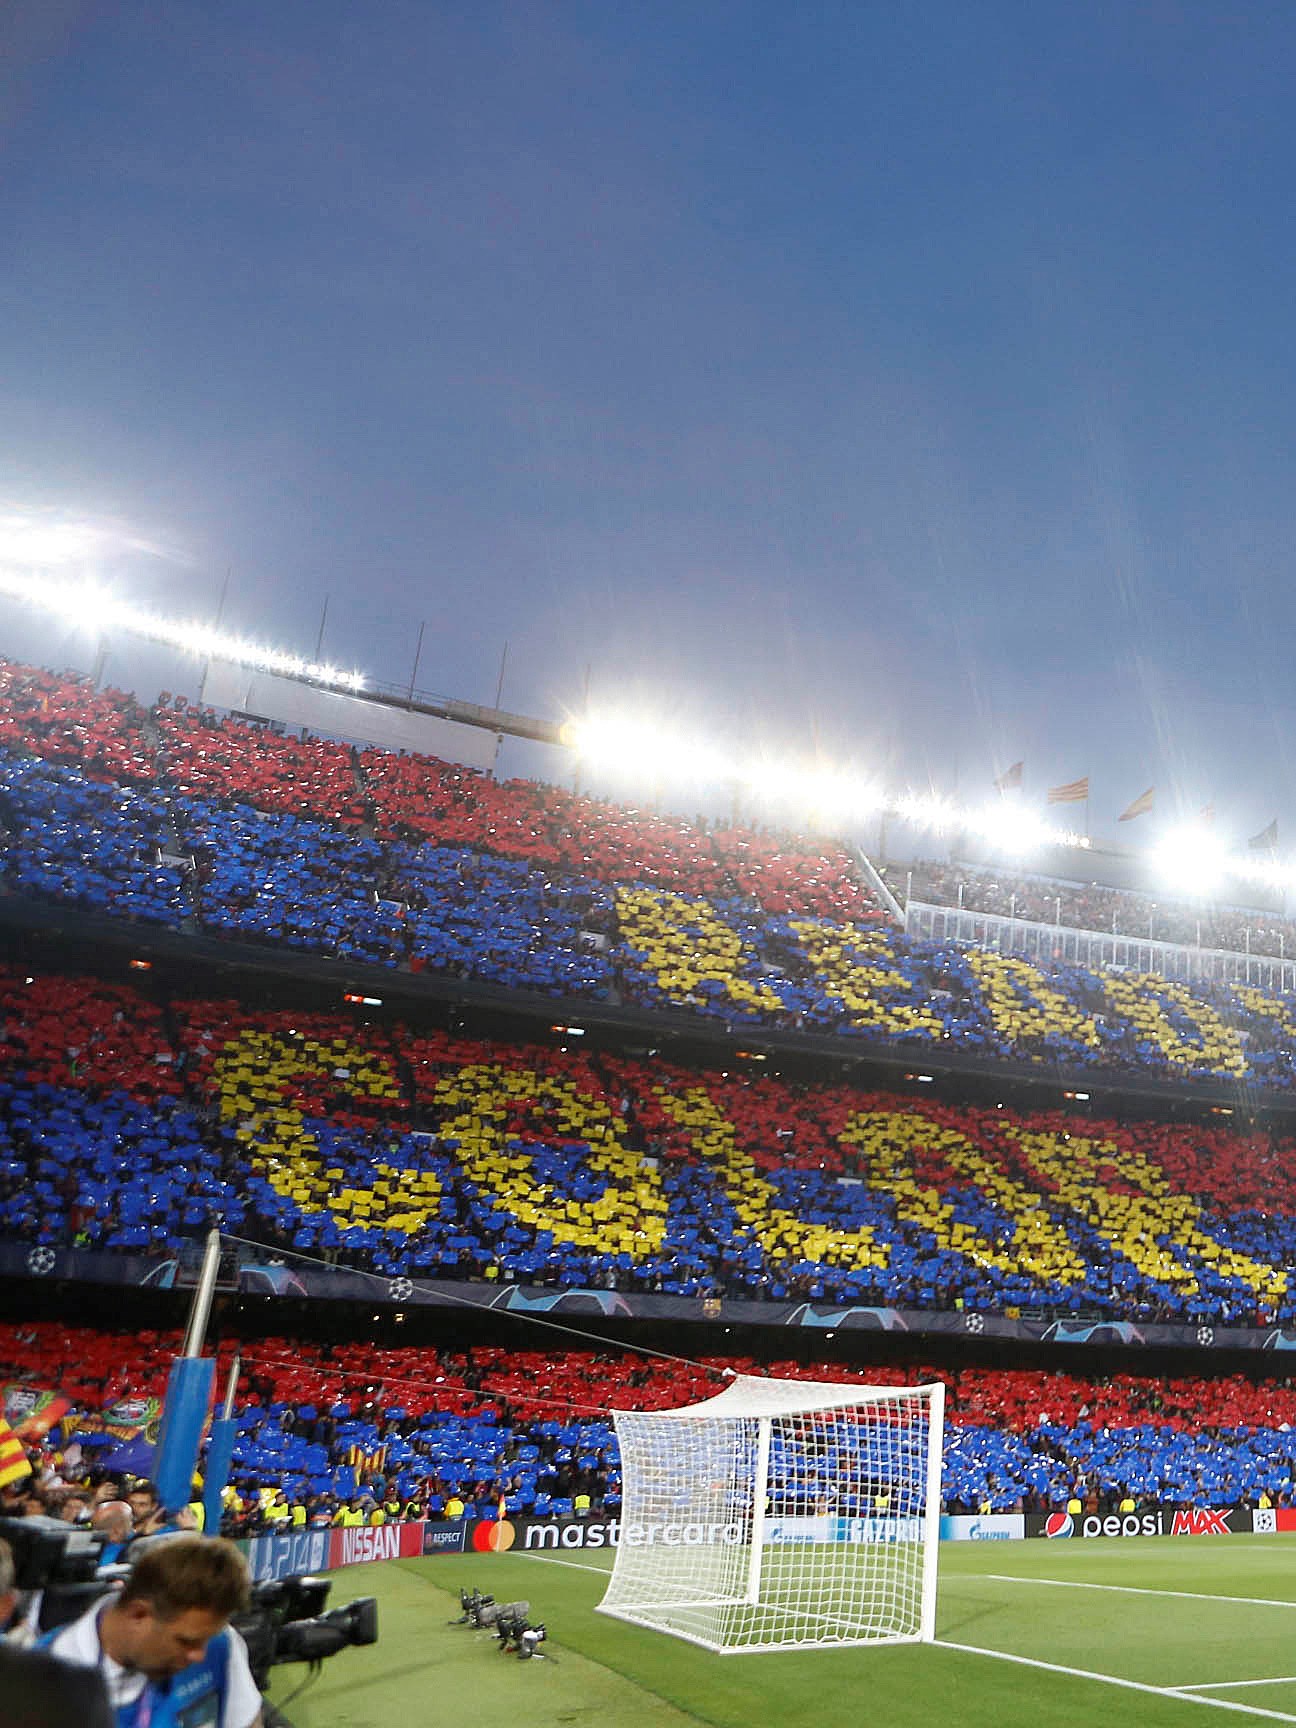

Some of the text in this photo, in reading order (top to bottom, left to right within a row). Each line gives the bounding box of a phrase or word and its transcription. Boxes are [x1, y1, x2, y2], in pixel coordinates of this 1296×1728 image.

[206, 1028, 1290, 1297] COLOR
[433, 1532, 462, 1544] RESPECT
[1083, 1508, 1234, 1538] pepsi MAX
[343, 1525, 401, 1564] NISSAN
